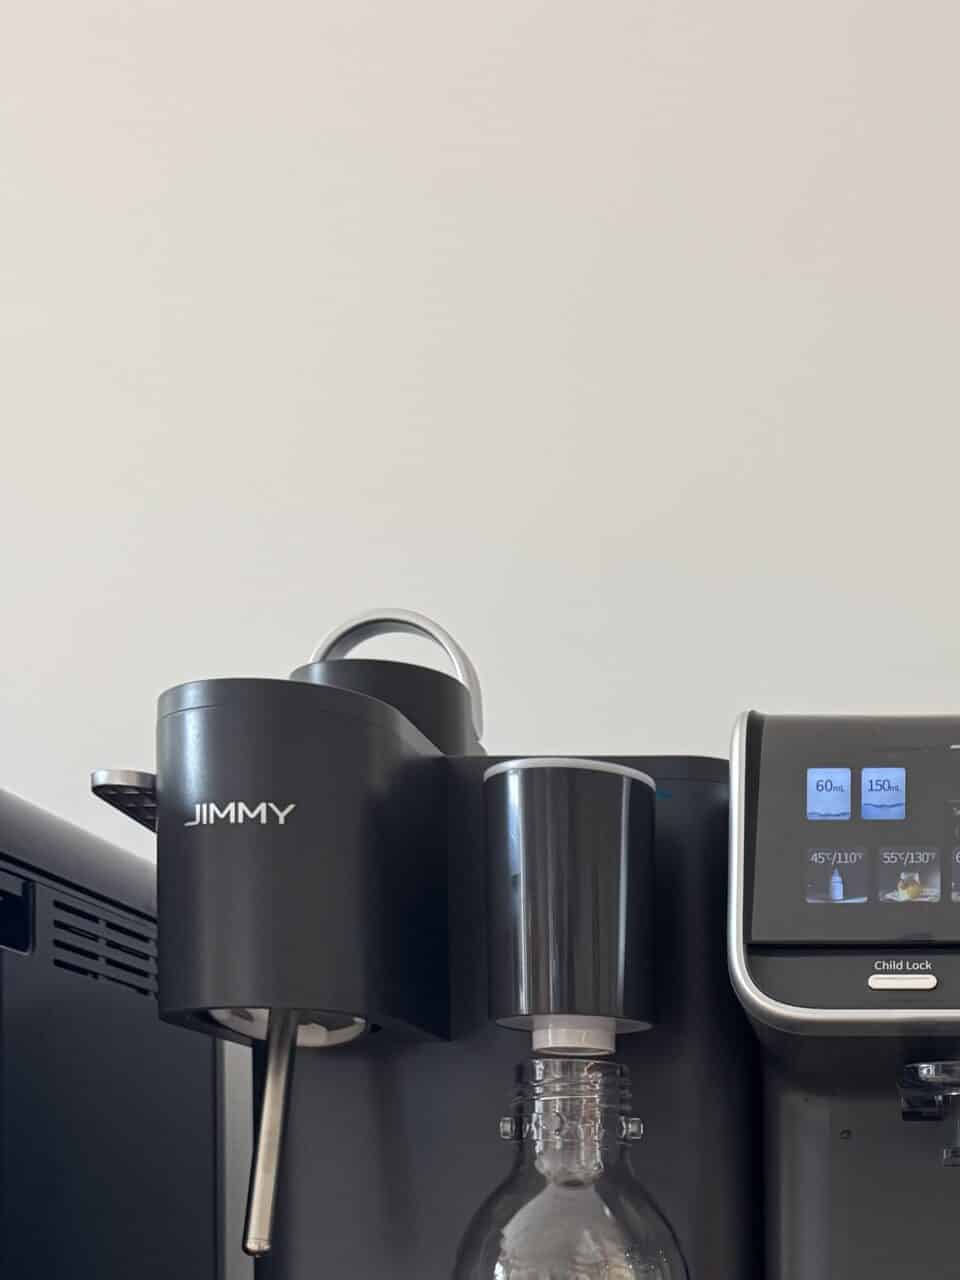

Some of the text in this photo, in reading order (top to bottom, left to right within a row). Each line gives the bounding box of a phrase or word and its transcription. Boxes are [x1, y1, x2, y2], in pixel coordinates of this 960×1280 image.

[184, 801, 297, 827] JIMMY
[874, 960, 932, 970] Child Lock
